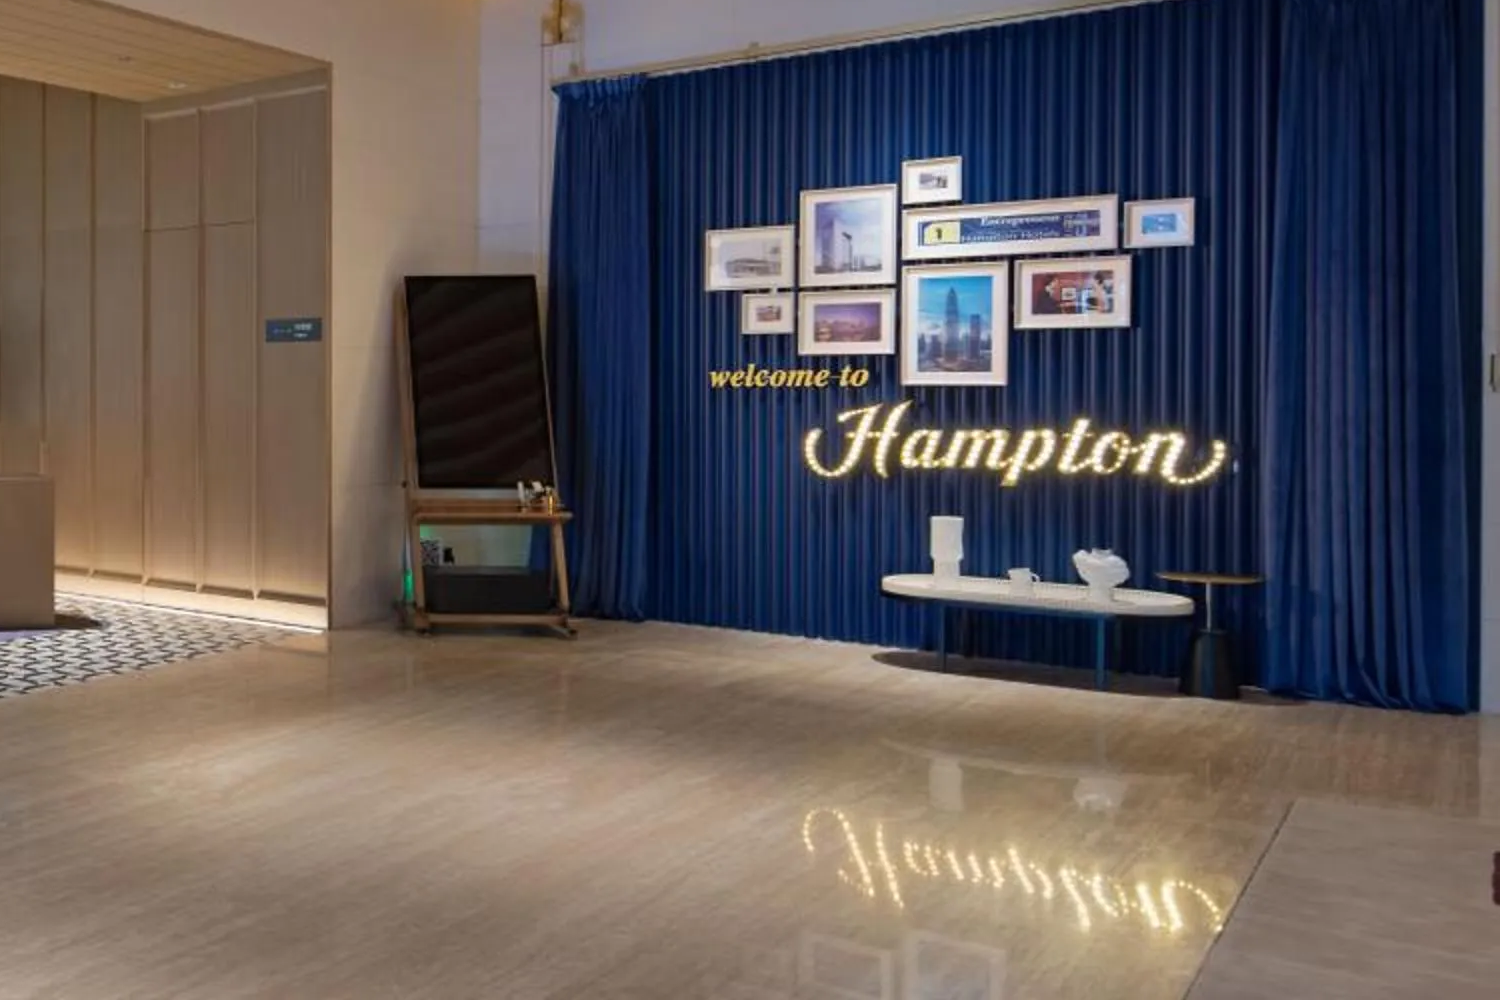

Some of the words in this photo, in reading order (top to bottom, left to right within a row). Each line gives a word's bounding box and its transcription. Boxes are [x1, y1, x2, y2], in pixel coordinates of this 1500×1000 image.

[709, 363, 831, 388] welcome
[839, 365, 870, 387] to
[804, 399, 1227, 487] Hampton
